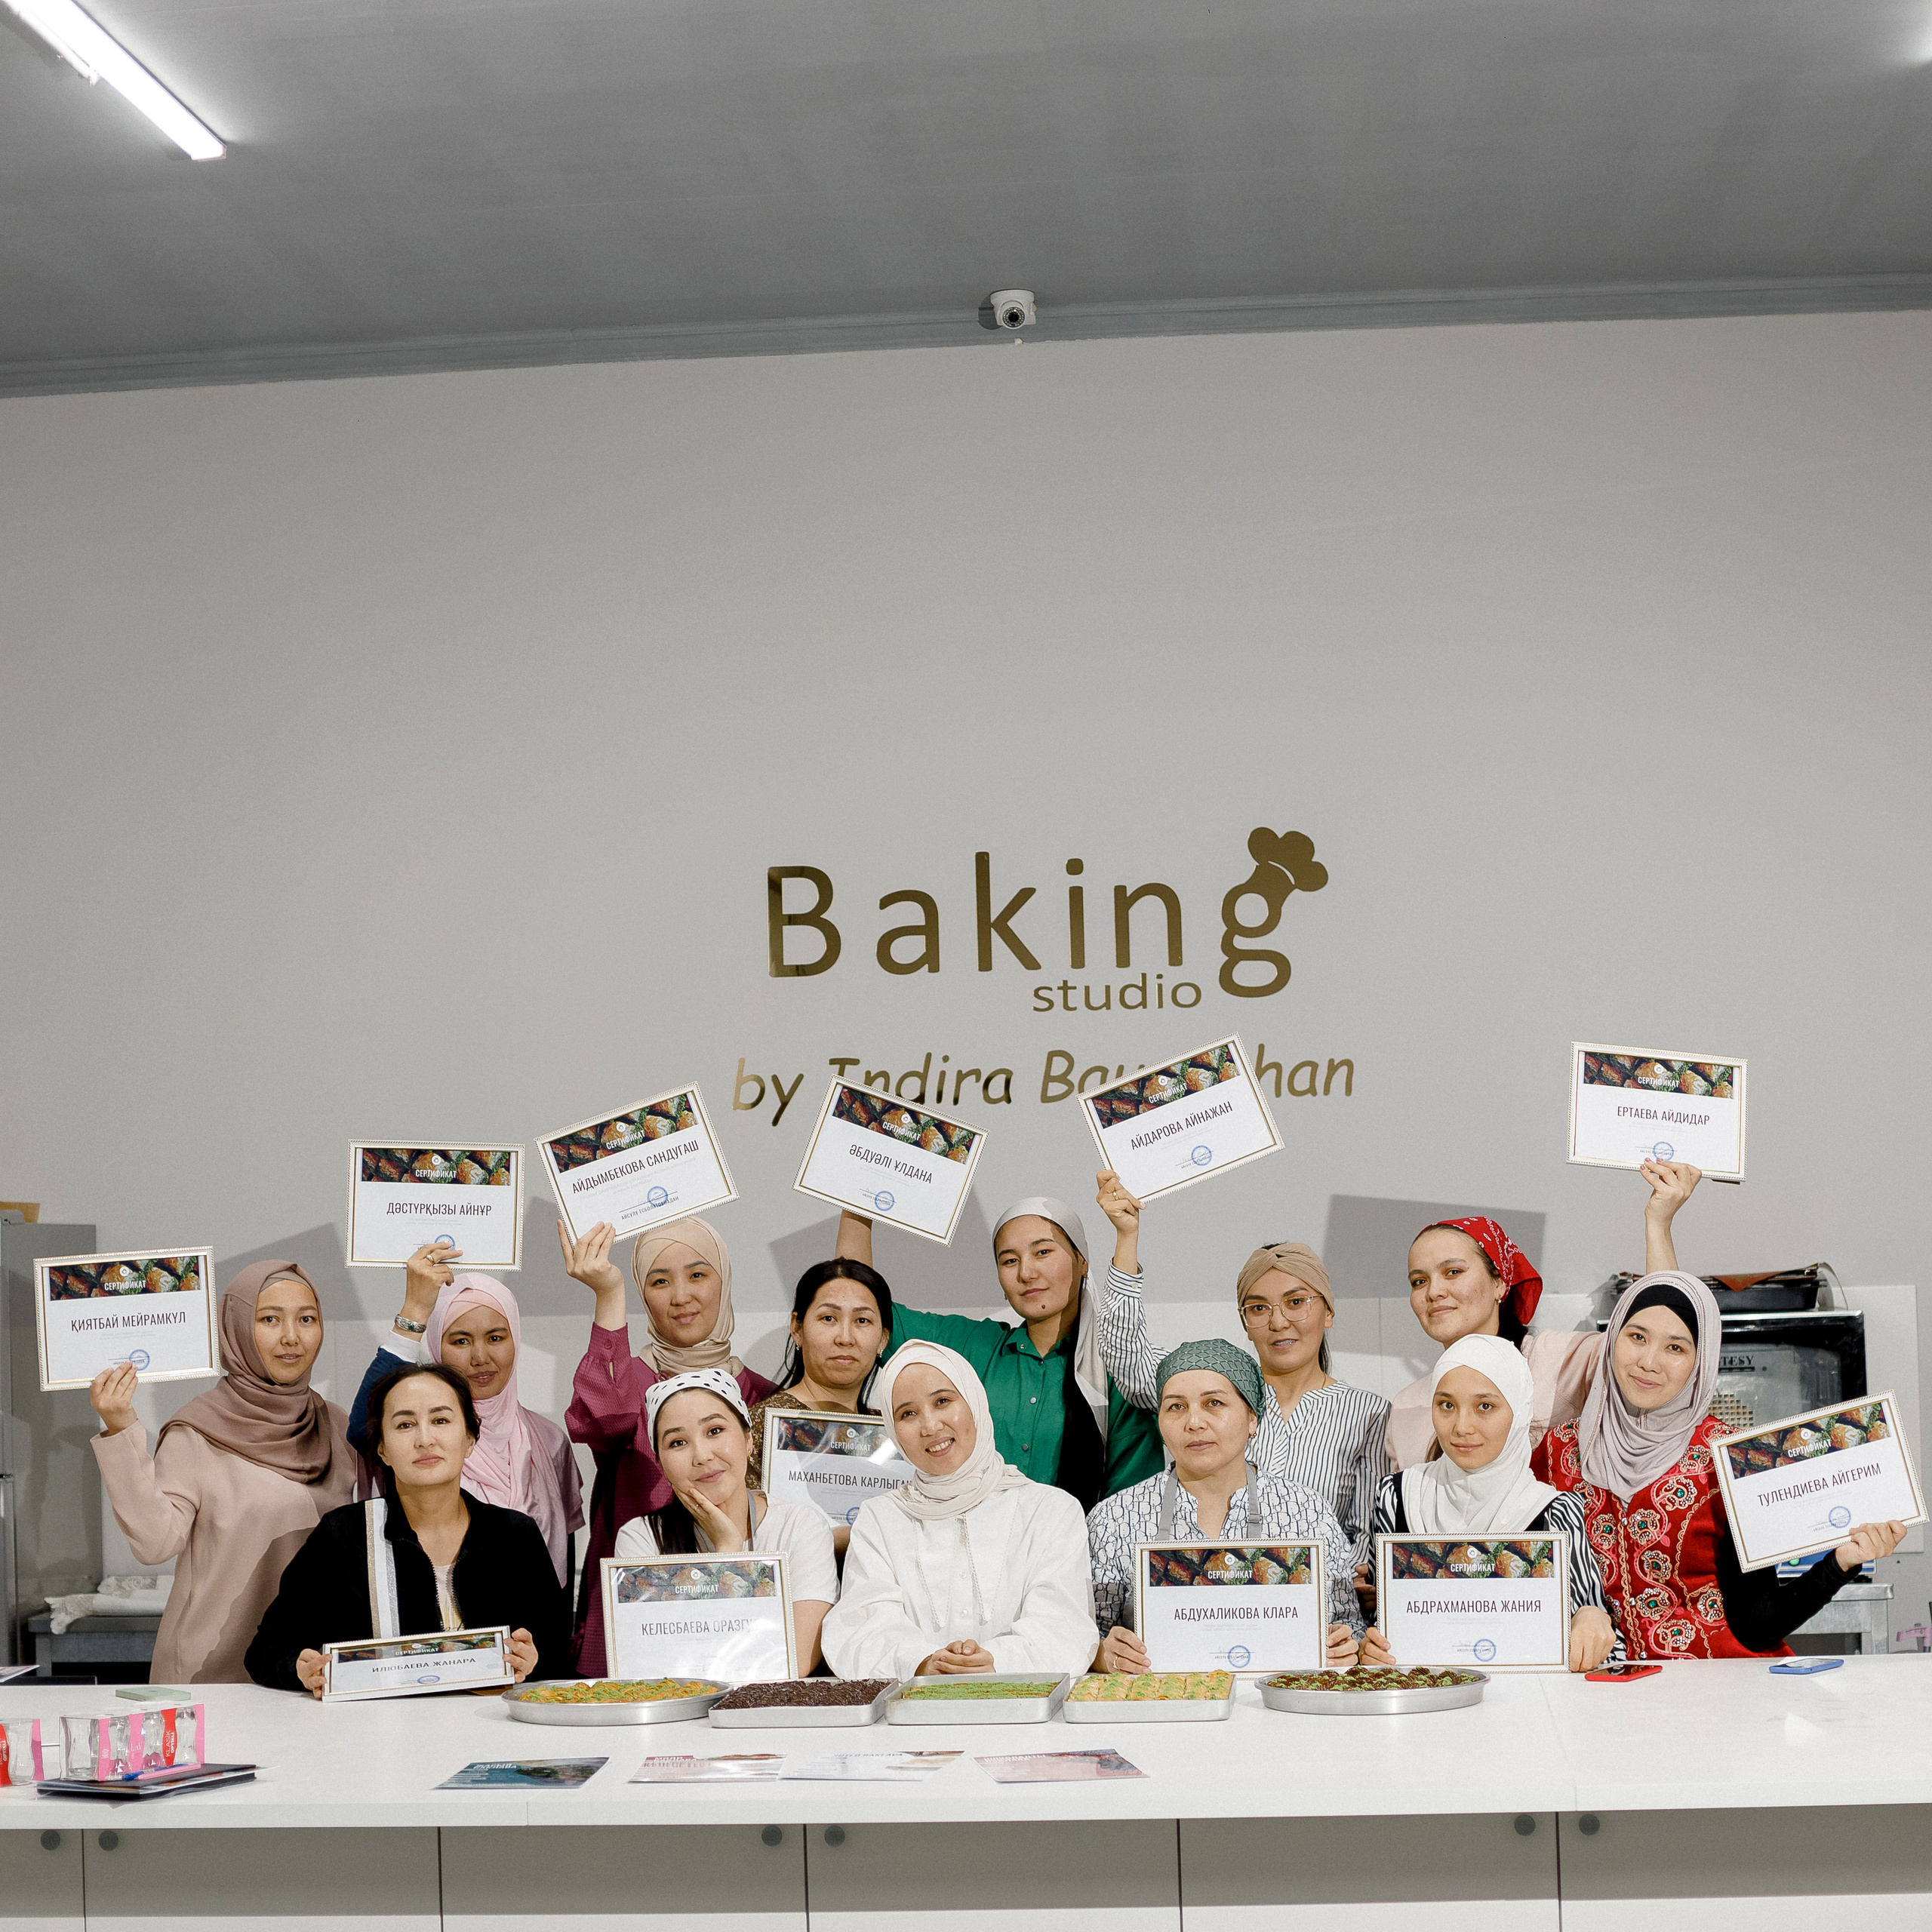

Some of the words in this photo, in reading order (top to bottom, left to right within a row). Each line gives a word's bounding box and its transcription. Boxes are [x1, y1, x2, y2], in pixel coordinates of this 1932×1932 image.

[767, 827, 1328, 998] Baking
[1032, 972, 1202, 1012] studio
[1638, 1076, 1679, 1088] СЕРТИФИКАТ
[732, 1057, 804, 1127] by
[1149, 1082, 1188, 1104] СЕРТИФИКАТ
[1131, 1121, 1183, 1150] АЙДАРОВА
[1185, 1101, 1233, 1129] АЙНАЖАН
[1617, 1106, 1658, 1120] ЕРТАЕВА
[1661, 1109, 1710, 1126] АЙДИДАР
[606, 1130, 645, 1149] СЕРТИФИКАТ
[882, 1121, 921, 1141] СЕРТИФИКАТ
[572, 1160, 645, 1194] АЙДЫМБЕКОВА
[646, 1140, 699, 1167] САНДУГАШ
[849, 1144, 892, 1169] ӘБДУӘЛІ
[894, 1160, 933, 1184] ҰЛДАНА
[415, 1170, 457, 1178] СЕРТИФИКАТ
[386, 1202, 456, 1217] ДӘСТҮРҚЫЗЫ
[460, 1202, 492, 1216] АЙНҰР
[104, 1280, 146, 1291] СЕРТИФИКАТ
[71, 1314, 119, 1333] ҚИЯТБАЙ
[122, 1311, 186, 1328] МЕЙРАМКҮЛ
[830, 1441, 871, 1452] СЕРТИФИКАТ
[1787, 1438, 1832, 1458] СЕРТИФИКАТ
[789, 1470, 858, 1487] МАХАНБЕТОВА
[860, 1476, 912, 1490] КАРЛЫГА
[1757, 1477, 1829, 1507] ТУЛЕНДИЕВА
[1832, 1463, 1881, 1487] АЙГЕРИМ
[1208, 1570, 1253, 1580] СЕРТИФИКАТ
[1451, 1563, 1495, 1573] СЕРТИФИКАТ
[675, 1585, 719, 1594] СЕРТИФИКАТ
[1174, 1607, 1260, 1622] АБДУХАЛИКОВА
[1263, 1607, 1299, 1620] КЛАРА
[1406, 1600, 1497, 1615] АБДРАХМАНОВА
[1500, 1599, 1541, 1613] ЖАНИЯ
[641, 1621, 710, 1635] КЕЛЕСБАЕВА
[713, 1619, 753, 1633] ОРАЗГУ
[432, 1657, 476, 1668] ЖАНАРА
